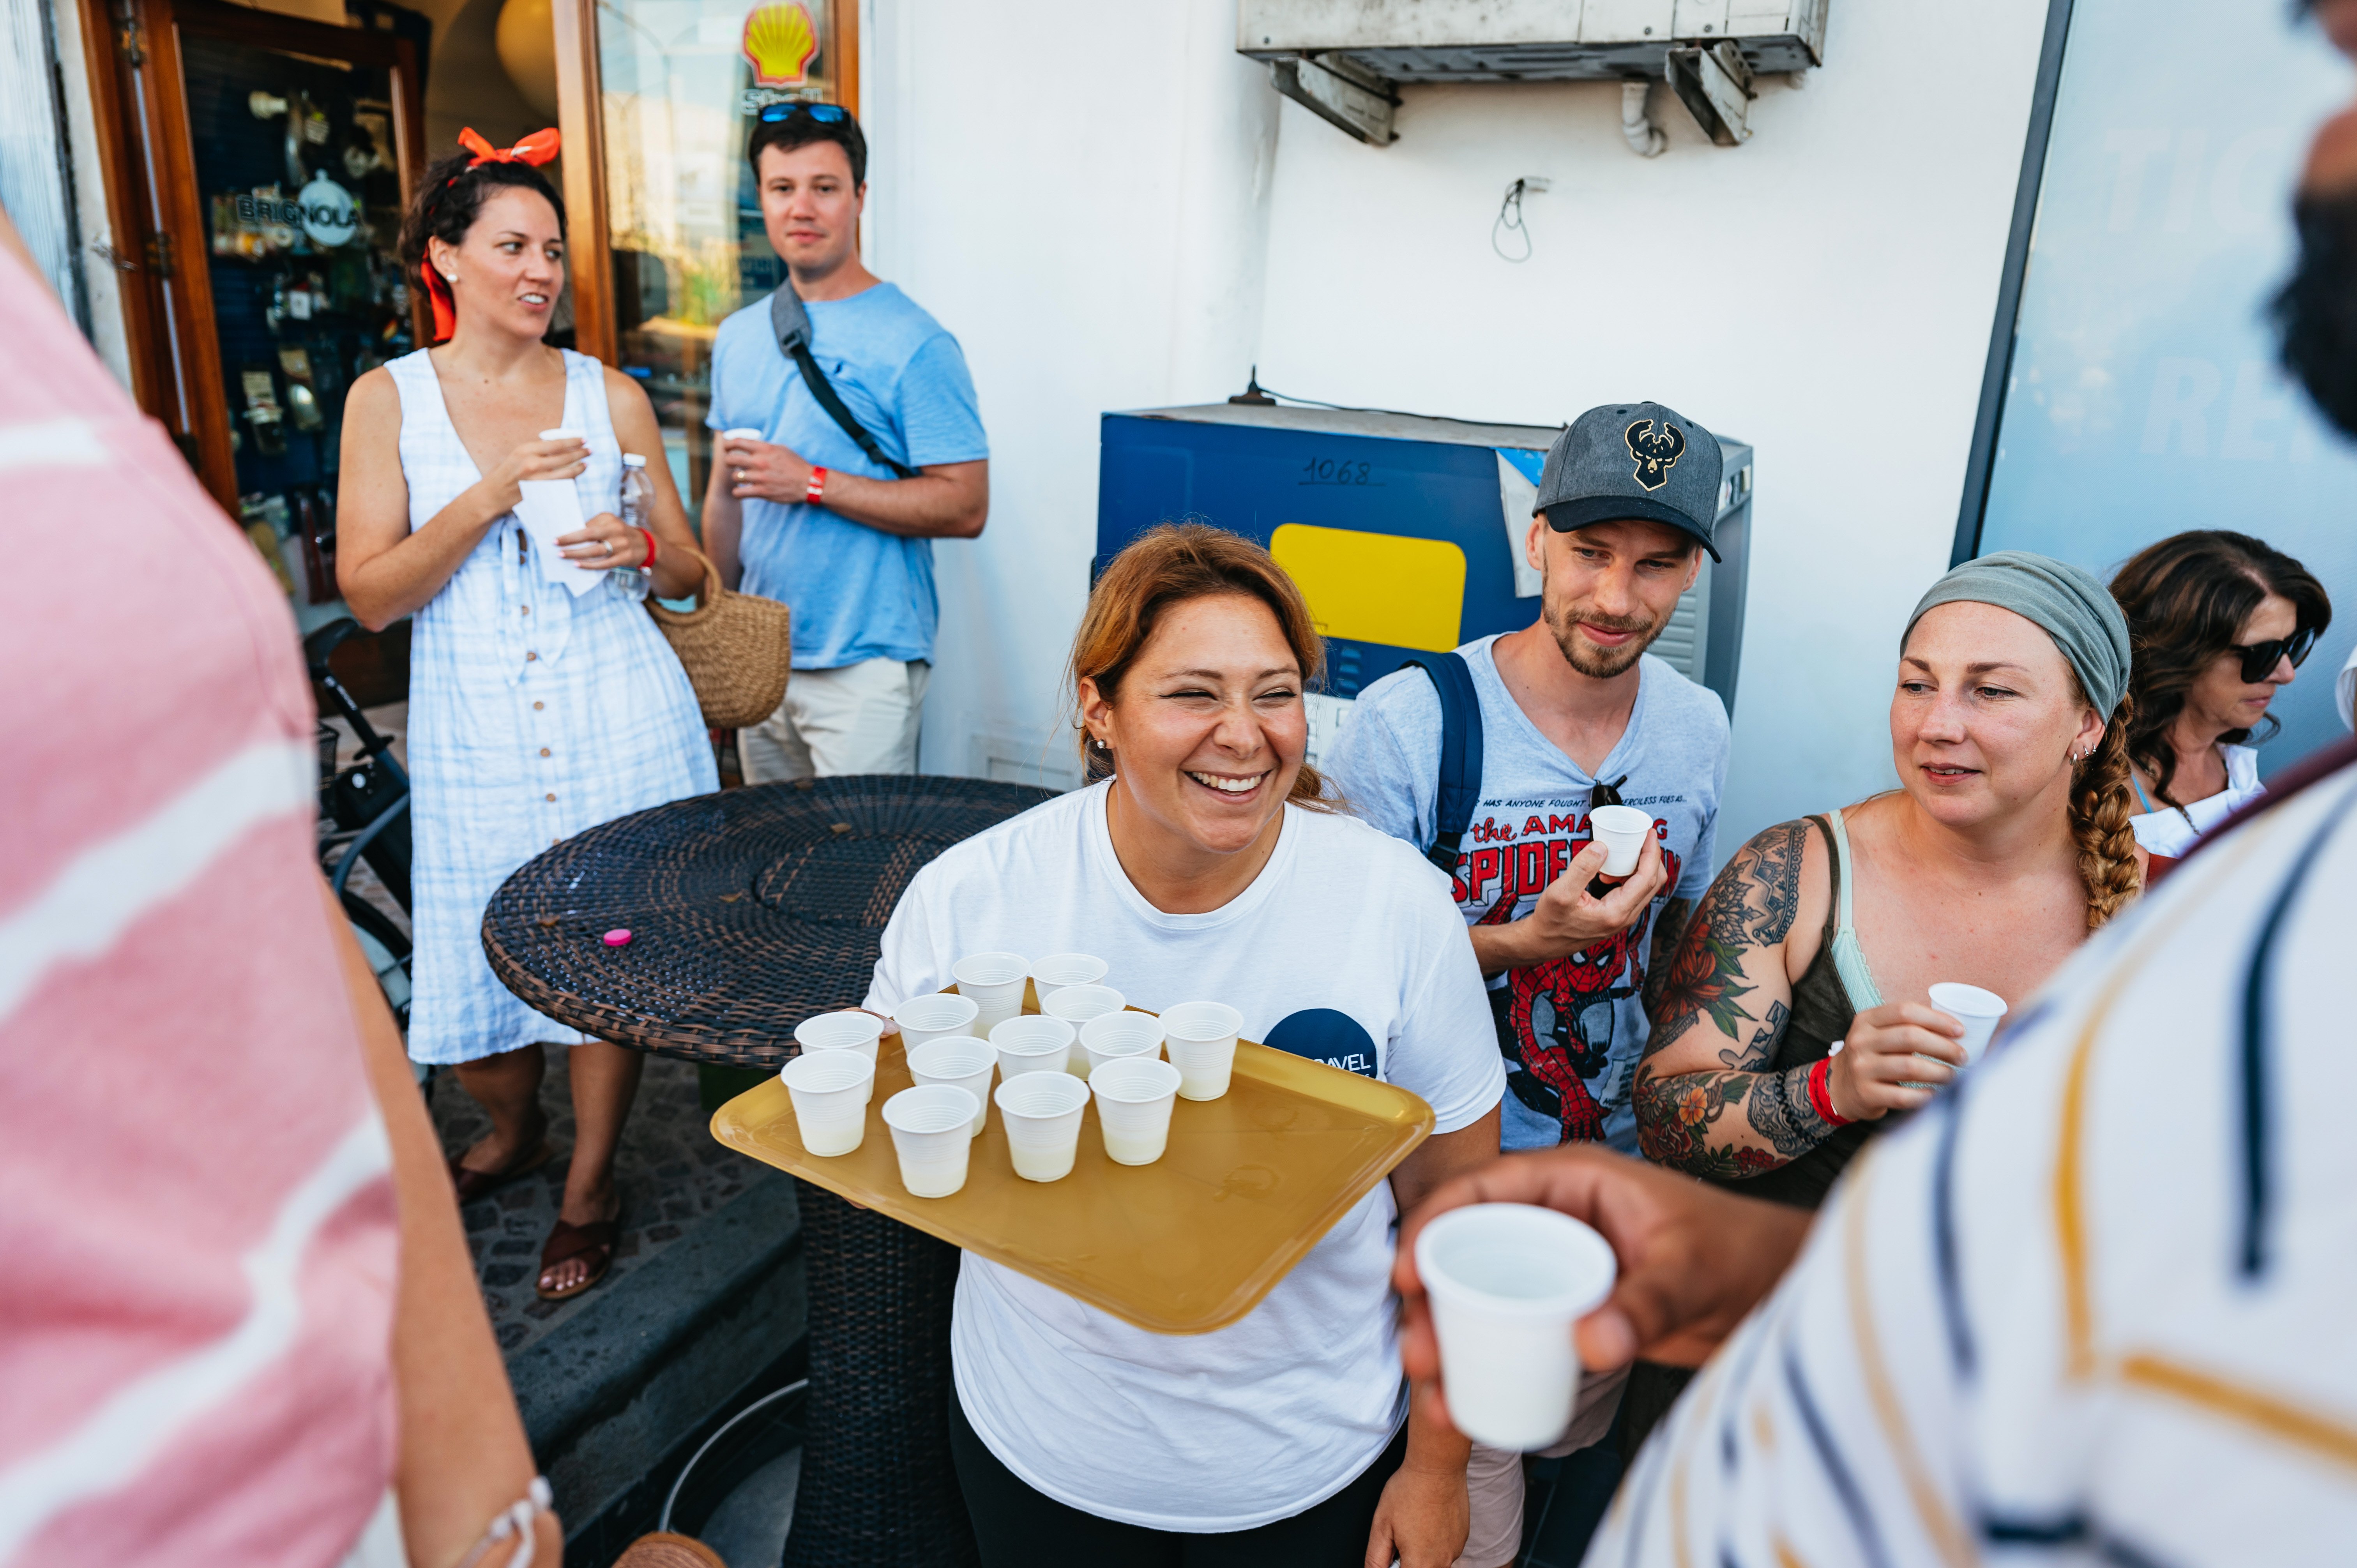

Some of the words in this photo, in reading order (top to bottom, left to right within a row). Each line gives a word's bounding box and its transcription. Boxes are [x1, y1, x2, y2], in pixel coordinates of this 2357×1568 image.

[1303, 457, 1370, 484] 1068
[1505, 799, 1546, 808] ANYONE
[1548, 799, 1587, 807] FOUGHT
[1622, 796, 1656, 807] ERCILESS
[1659, 795, 1675, 803] FOES
[1470, 817, 1517, 842] the
